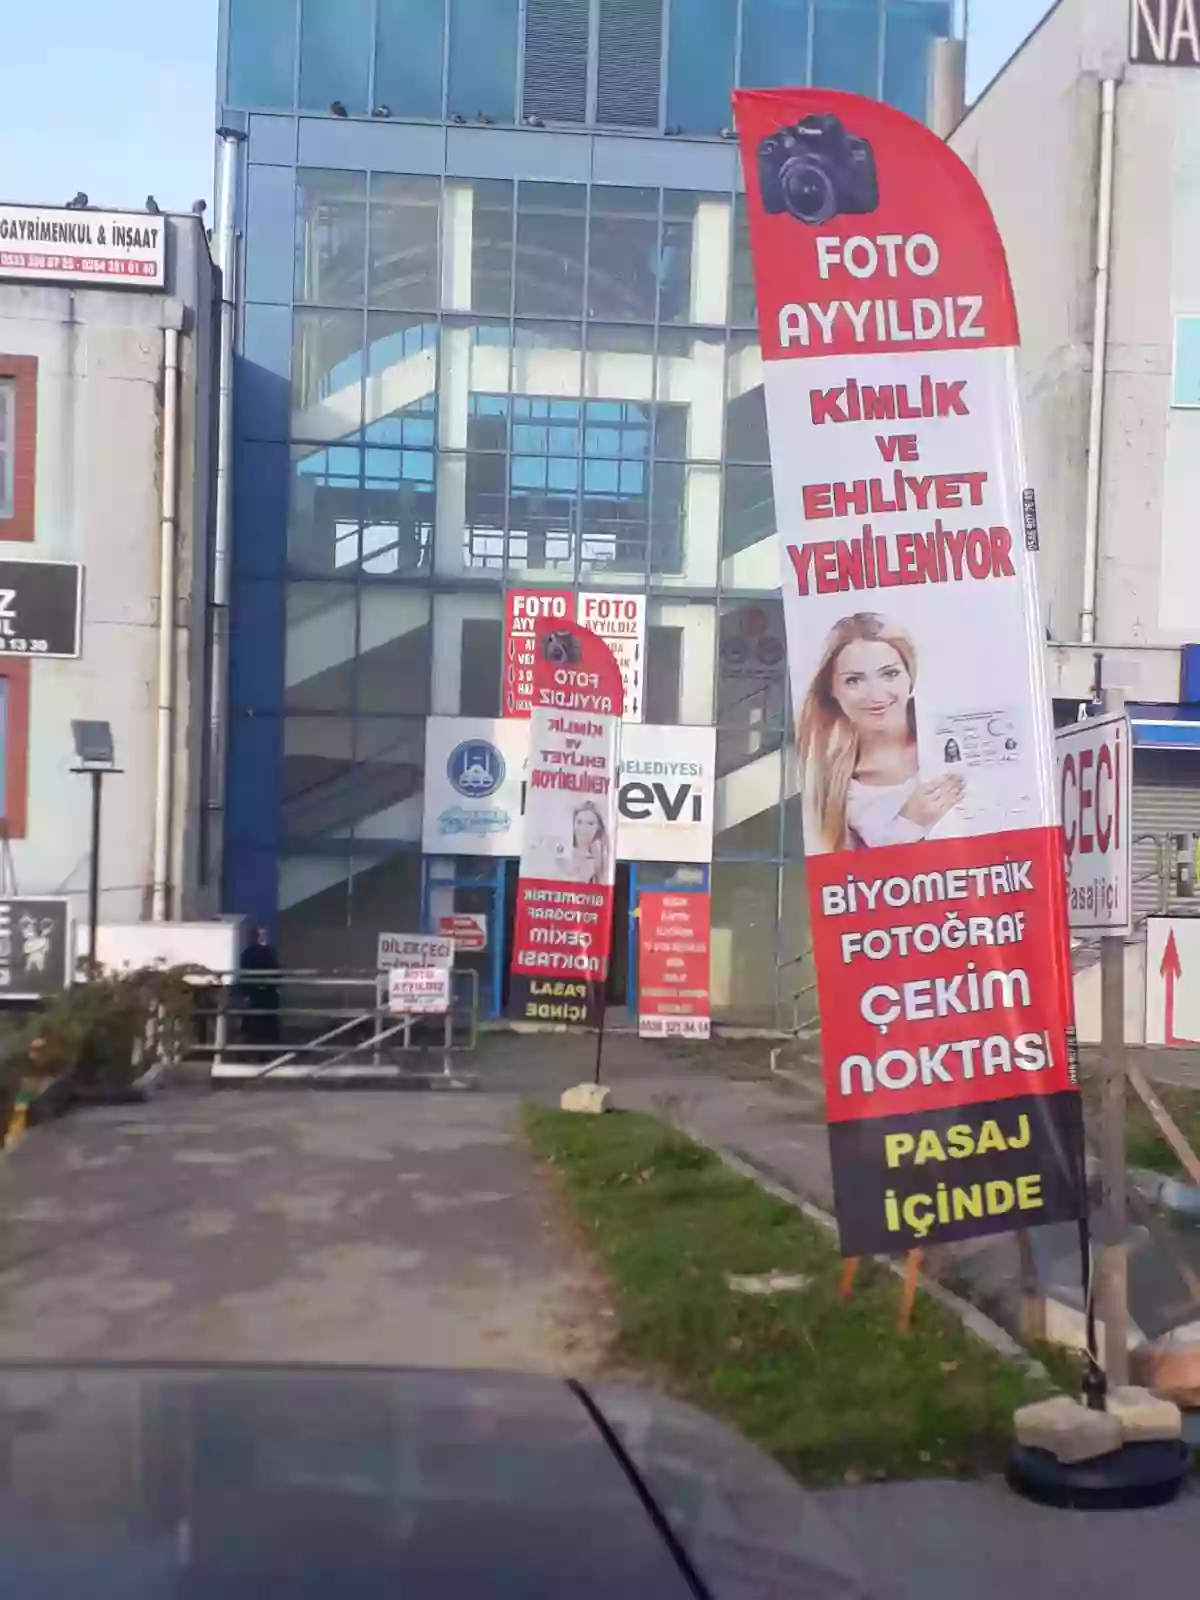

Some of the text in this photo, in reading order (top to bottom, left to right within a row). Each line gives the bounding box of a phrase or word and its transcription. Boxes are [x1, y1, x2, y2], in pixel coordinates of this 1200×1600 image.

[0, 216, 158, 252] GAYRİMENKUL & İNŞAAT
[815, 233, 939, 279] FOTO
[778, 295, 986, 348] AYYILDIZ
[809, 374, 970, 425] KİMLİK
[874, 434, 919, 462] VE
[802, 469, 988, 520] EHLİYET
[786, 518, 1016, 596] YENİLENİYOR
[513, 595, 567, 617] FOTO
[585, 600, 637, 620] FOTO
[821, 856, 1034, 916] BİYOMETRİK
[841, 911, 1025, 964] FOTOĞRAF
[860, 961, 1032, 1035] ÇEKİM
[840, 1029, 1054, 1096] NOKTASI
[884, 1113, 1032, 1169] PASAJ
[884, 1174, 1044, 1238] İÇİNDE
